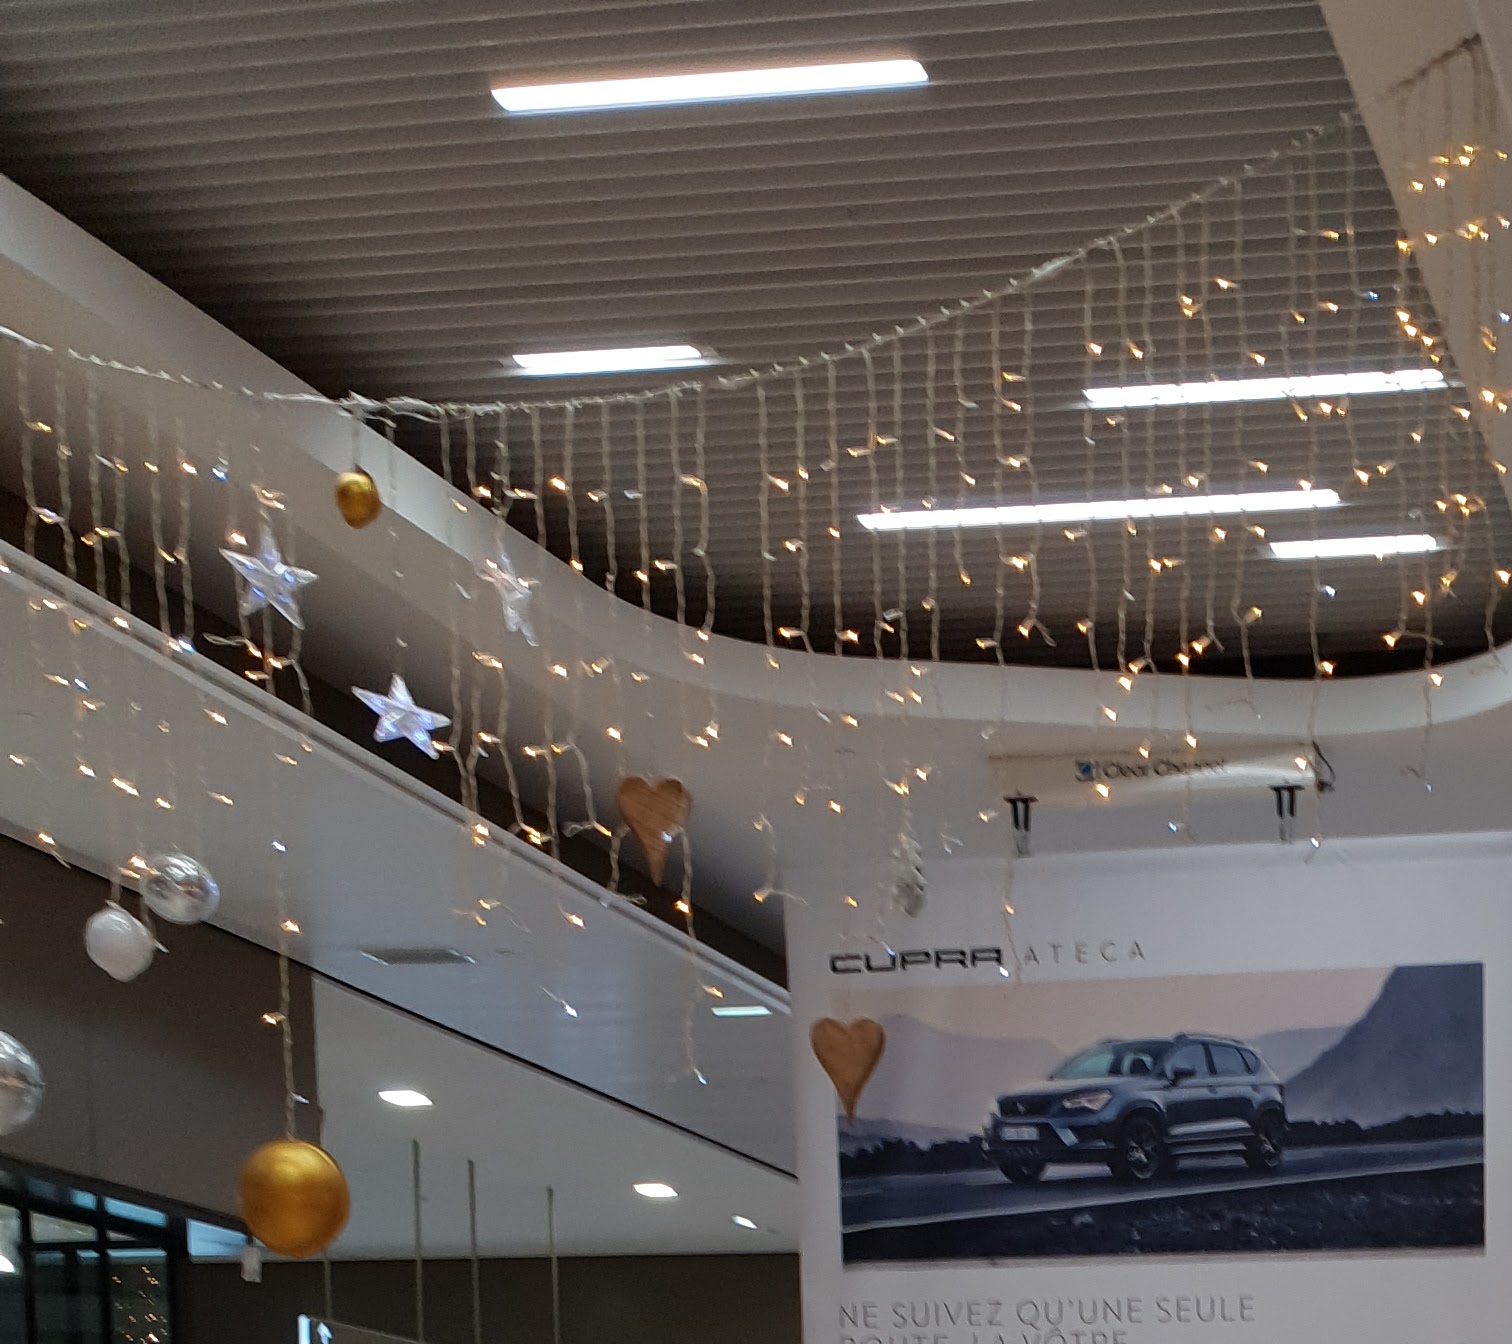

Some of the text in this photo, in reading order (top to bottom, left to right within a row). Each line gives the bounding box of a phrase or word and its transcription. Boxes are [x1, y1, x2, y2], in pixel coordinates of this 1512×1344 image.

[829, 938, 1147, 974] CUPRA ATECA
[838, 1294, 1257, 1331] NE SUIVEZ QU'UNE SEULE
